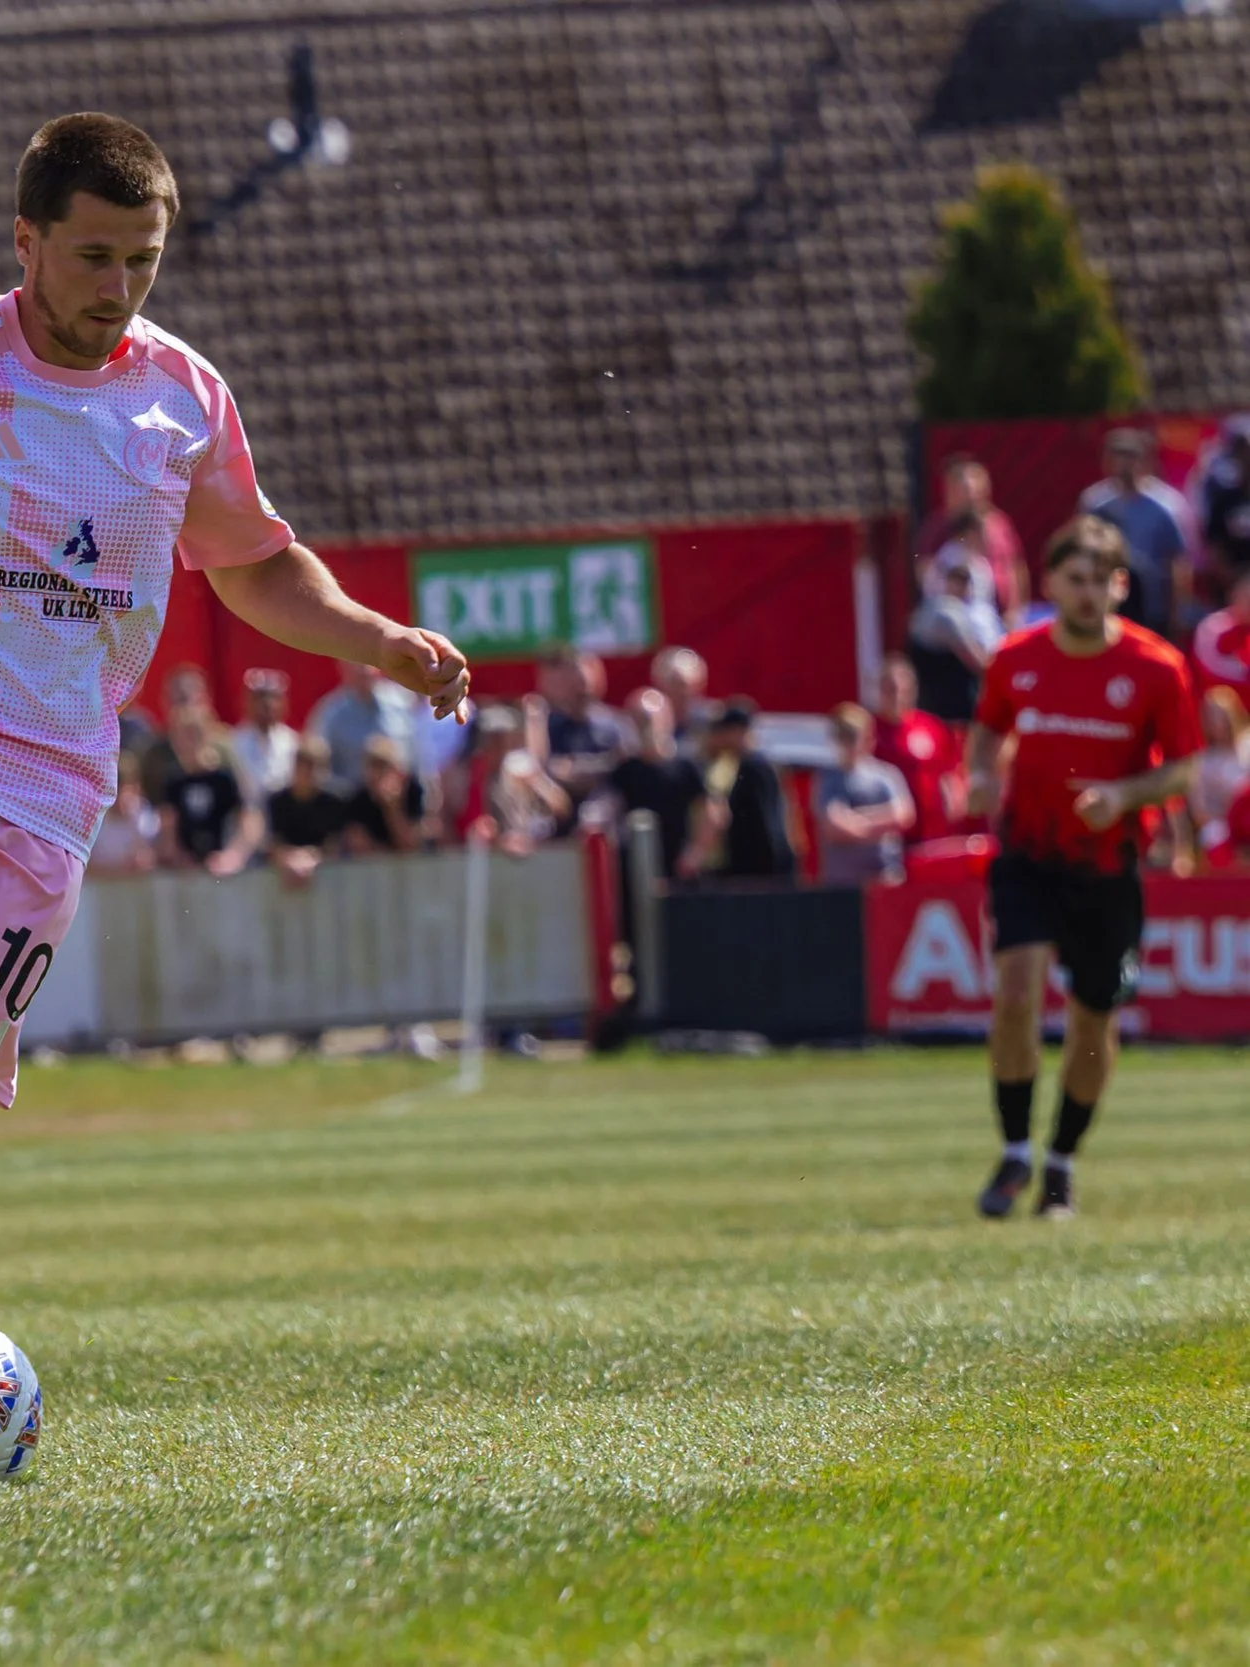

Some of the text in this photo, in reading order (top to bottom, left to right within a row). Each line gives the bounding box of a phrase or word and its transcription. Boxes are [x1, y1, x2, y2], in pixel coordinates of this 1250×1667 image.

[42, 598, 100, 621] UK LTD.
[82, 586, 134, 610] STEELS
[420, 567, 556, 642] EXIT
